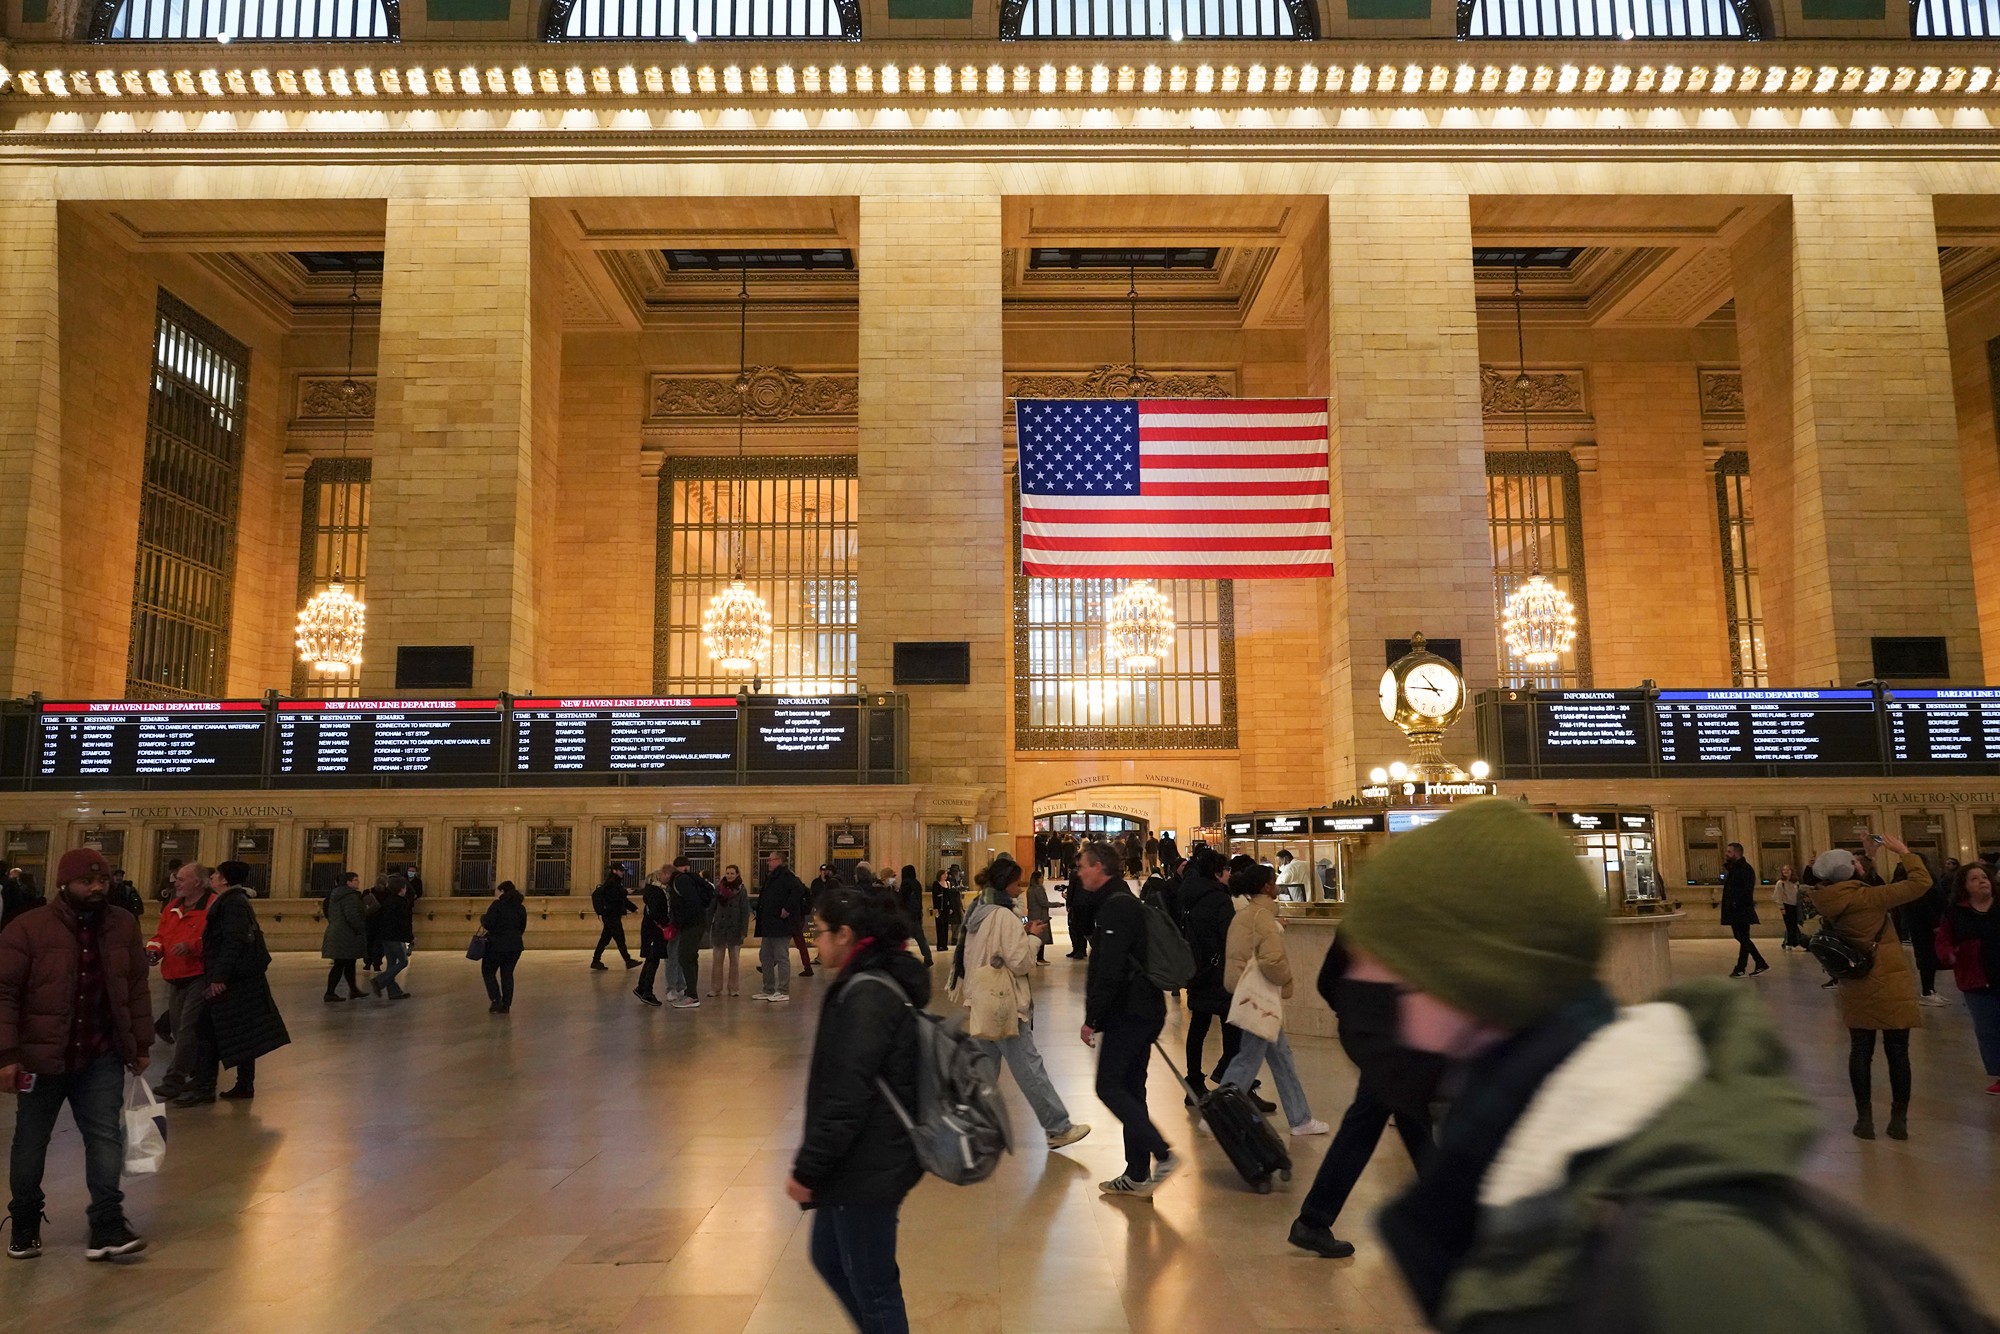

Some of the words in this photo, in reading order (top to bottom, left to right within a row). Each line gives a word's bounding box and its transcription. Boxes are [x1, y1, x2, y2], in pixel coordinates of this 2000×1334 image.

[1084, 775, 1110, 783] STREET
[1146, 775, 1191, 786] VANDERBILT
[1192, 781, 1210, 790] HALL
[1428, 783, 1486, 795] Information
[1872, 793, 1898, 802] MTA
[1902, 792, 1994, 802] METRO-NORTH
[130, 808, 170, 817] TICKET
[174, 807, 229, 817] VENDING
[233, 807, 293, 816] MACHINES
[1131, 808, 1149, 816] TAXIS
